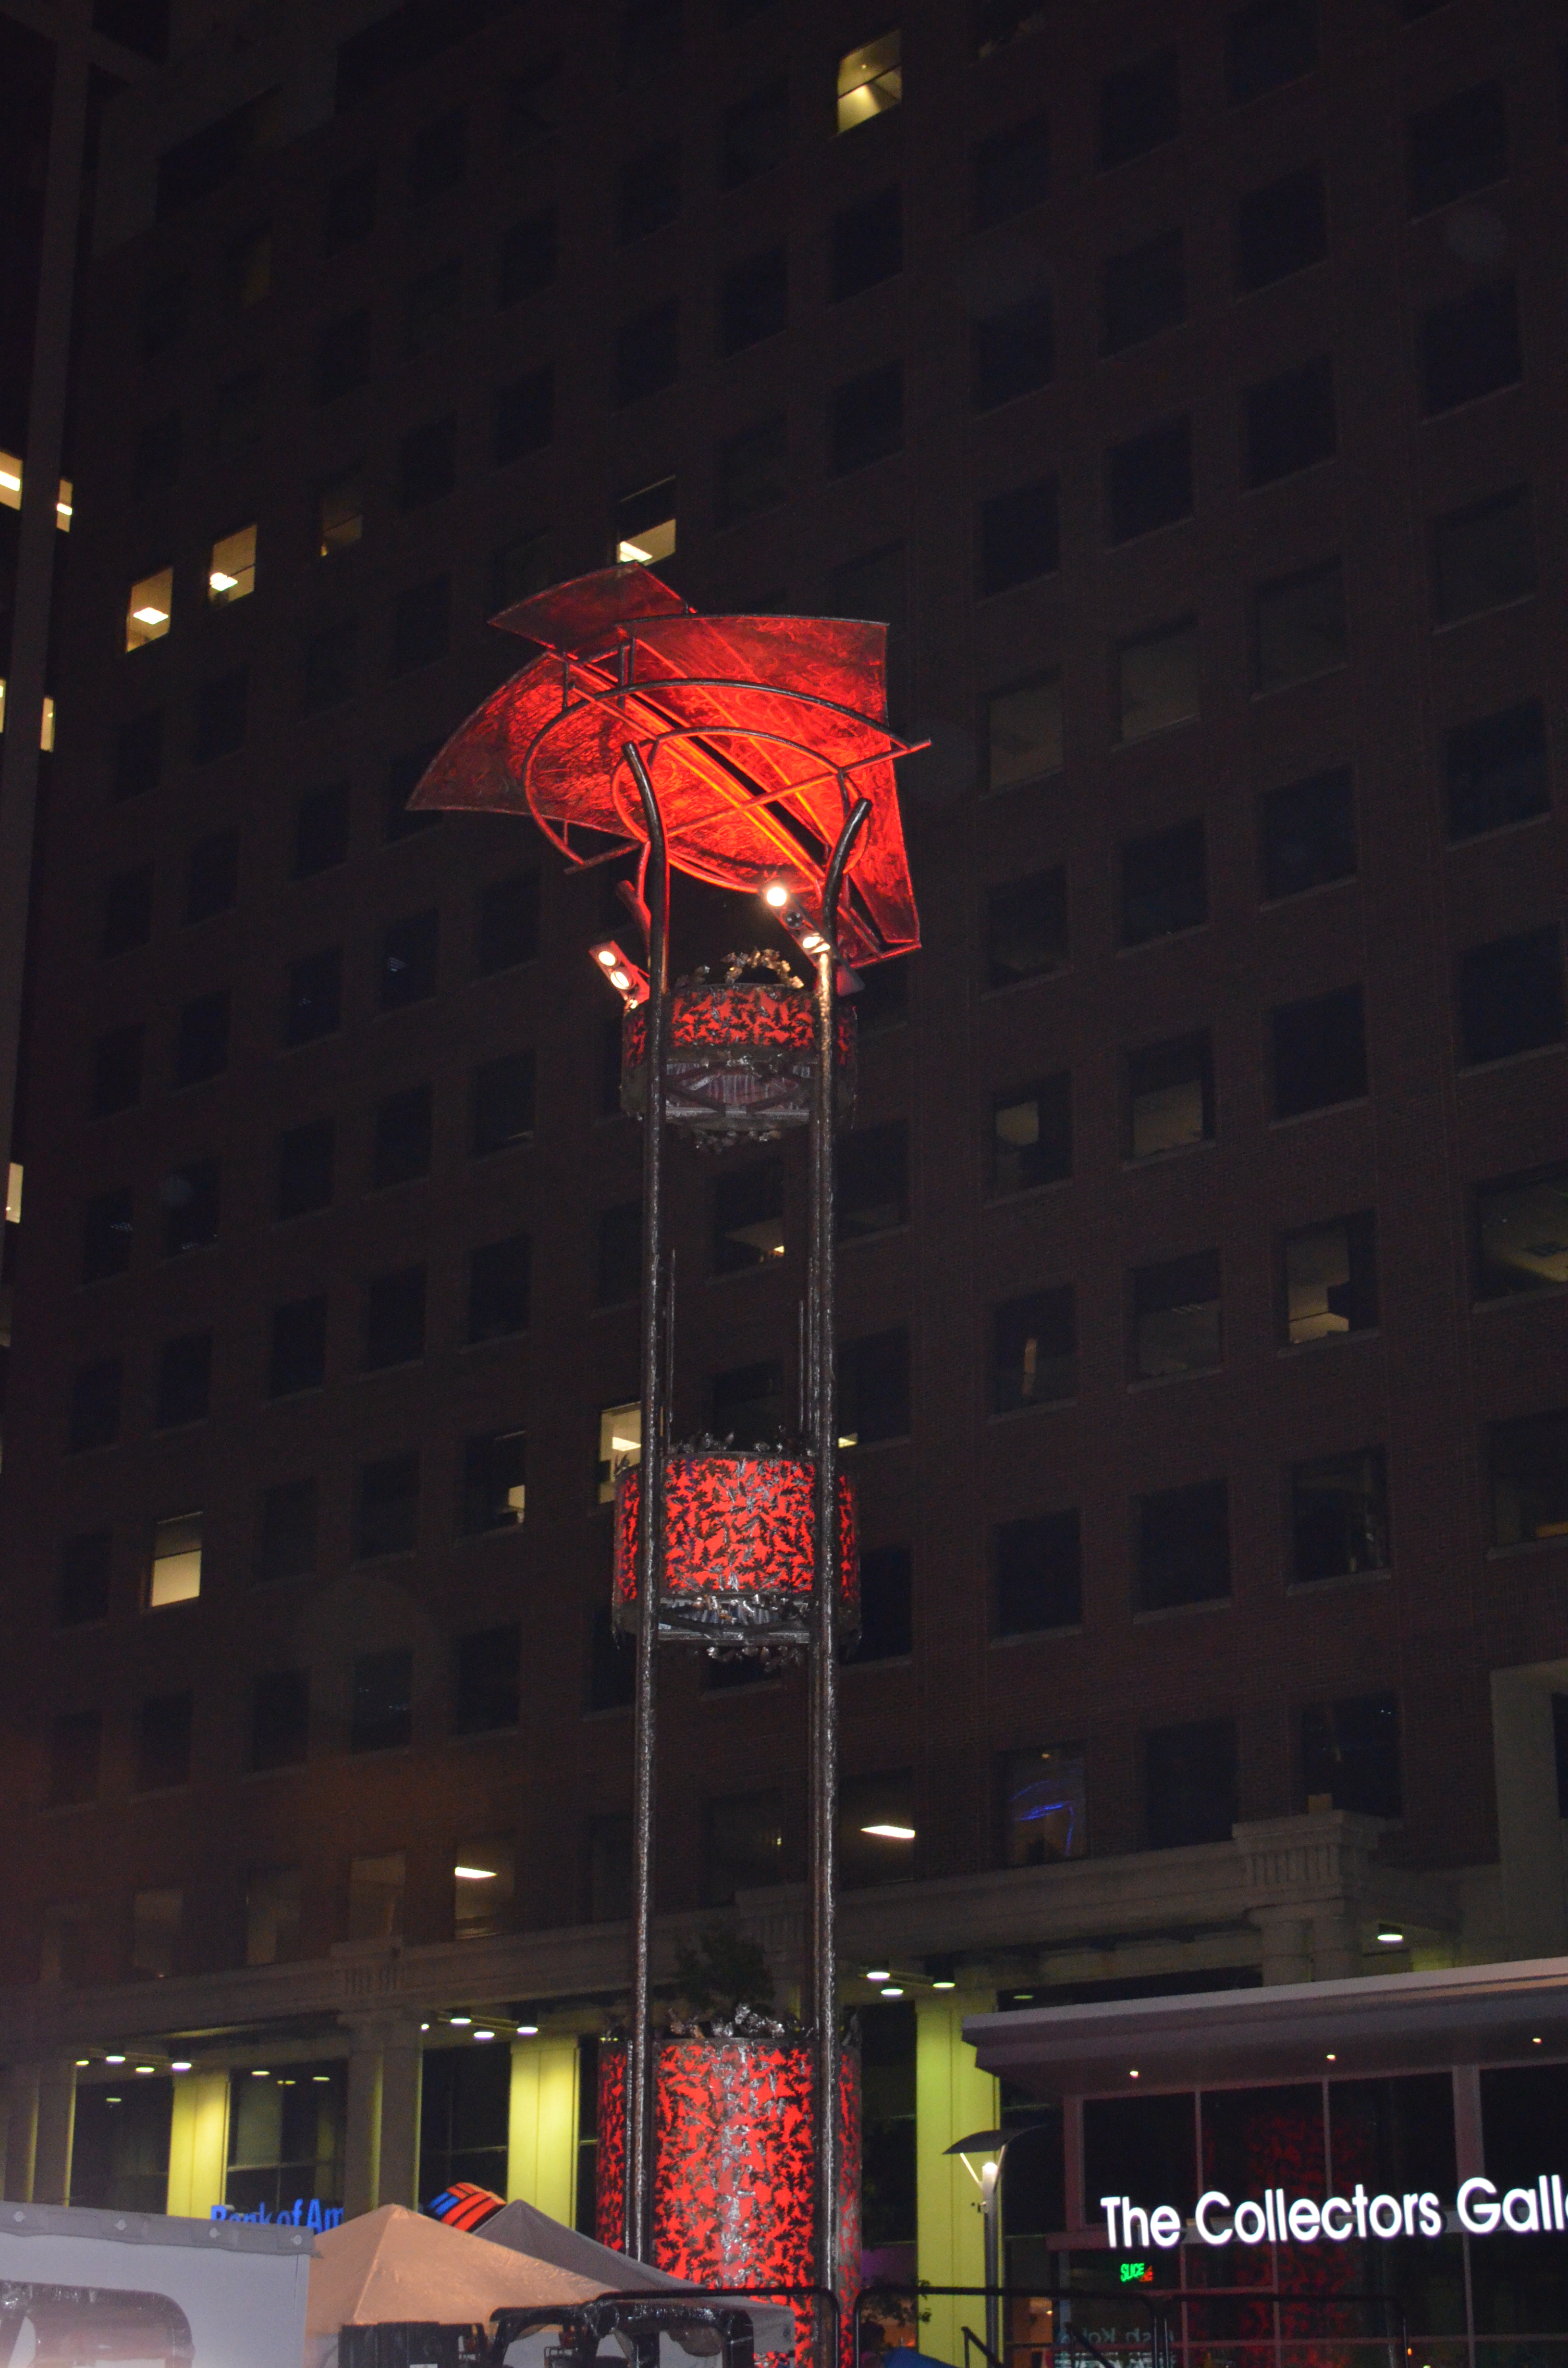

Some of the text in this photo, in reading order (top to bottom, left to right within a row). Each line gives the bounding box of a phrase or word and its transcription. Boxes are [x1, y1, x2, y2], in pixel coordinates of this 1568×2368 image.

[1100, 2174, 1568, 2248] The Collectors Gall
[1121, 2263, 1145, 2282] SLICE
